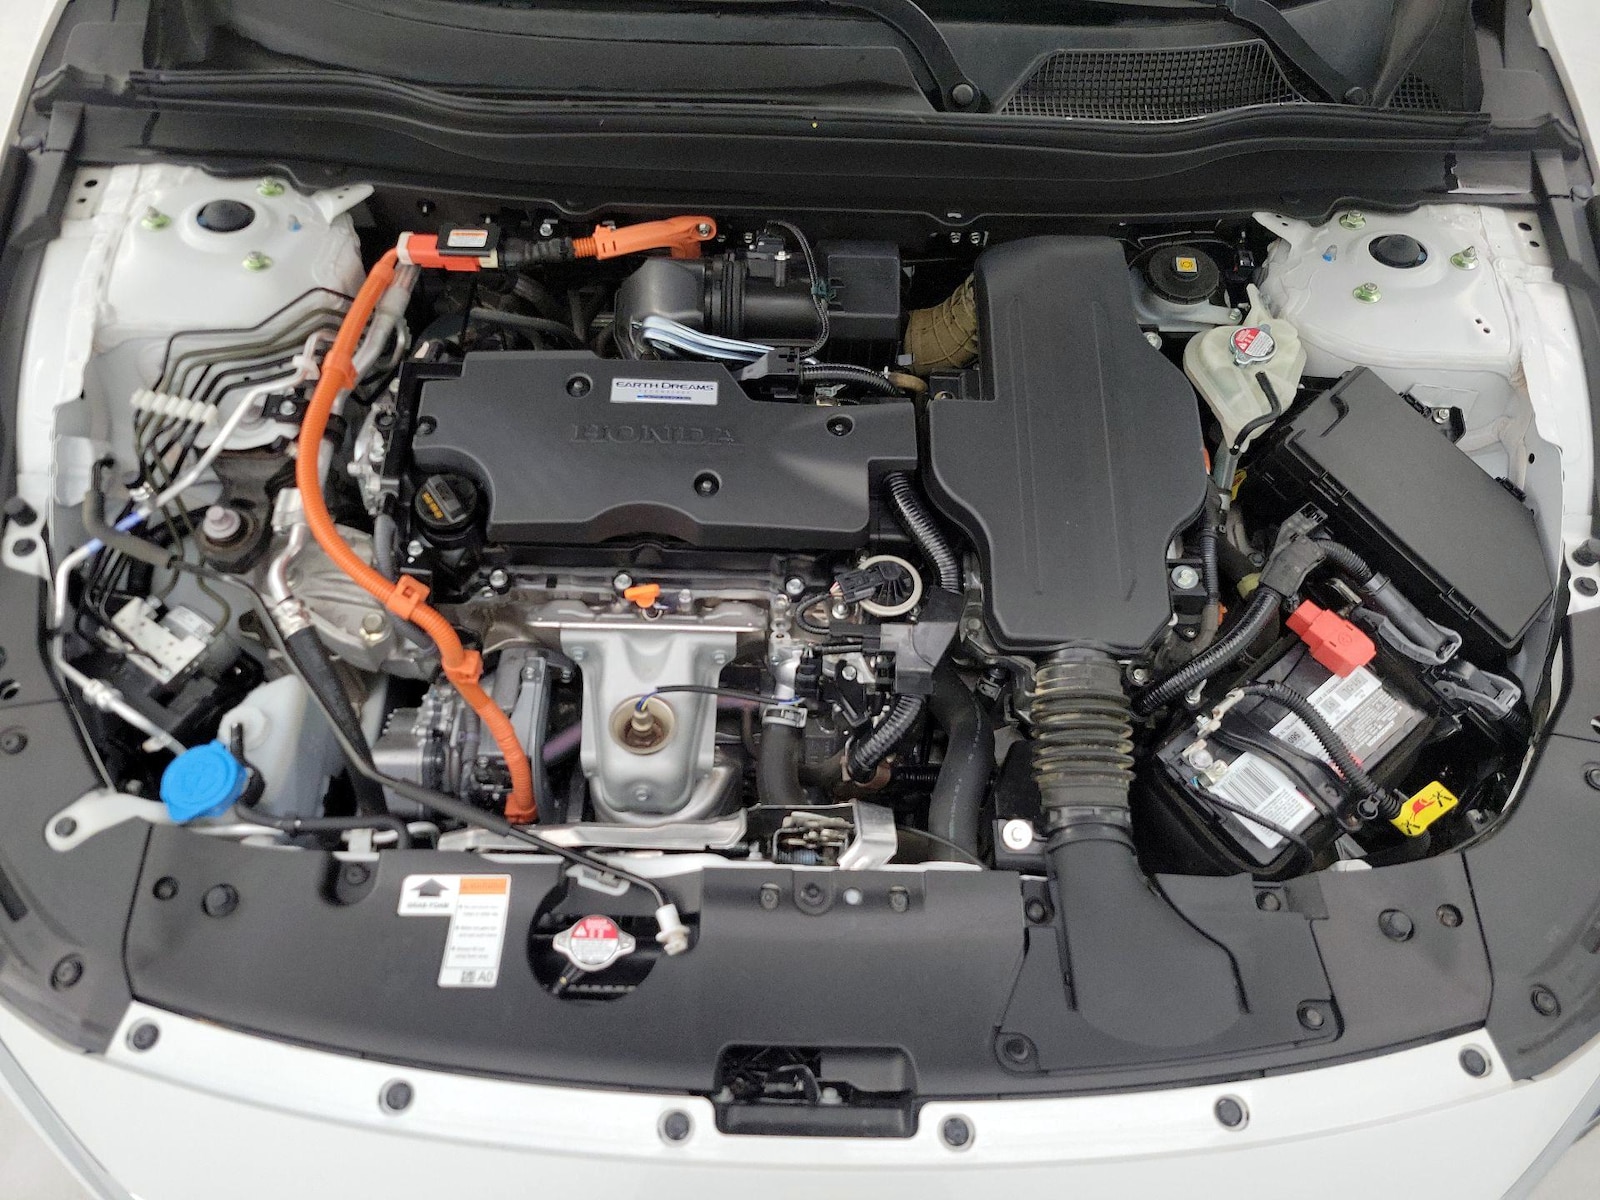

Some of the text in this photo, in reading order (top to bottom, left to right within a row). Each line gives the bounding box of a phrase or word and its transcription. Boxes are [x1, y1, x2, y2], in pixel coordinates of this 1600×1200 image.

[616, 381, 714, 391] EARTH DREAMS
[570, 422, 745, 445] HONDA
